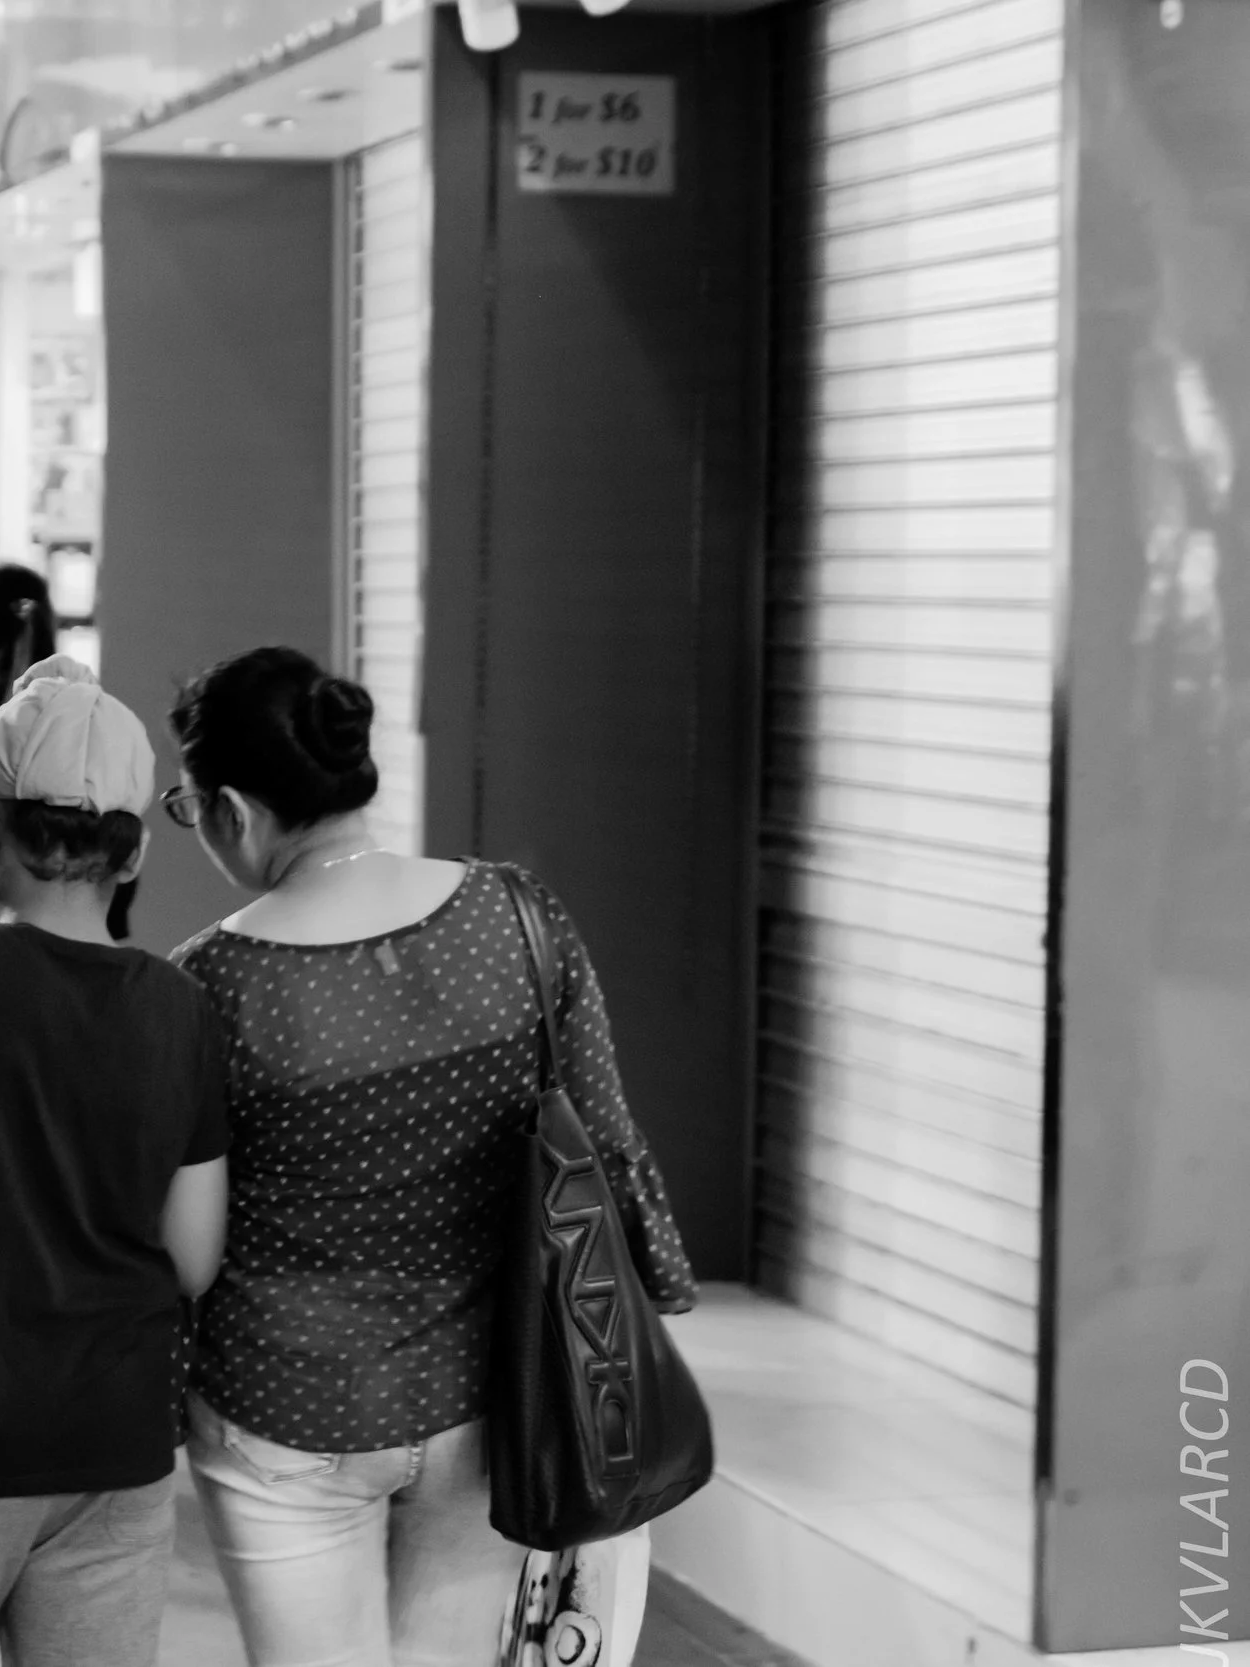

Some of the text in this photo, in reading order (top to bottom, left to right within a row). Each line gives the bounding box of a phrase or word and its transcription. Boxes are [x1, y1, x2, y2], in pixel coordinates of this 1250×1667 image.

[528, 89, 546, 120] 1
[598, 88, 642, 123] $6
[526, 144, 548, 174] 2
[596, 145, 659, 178] $10
[540, 1138, 640, 1476] DKNY
